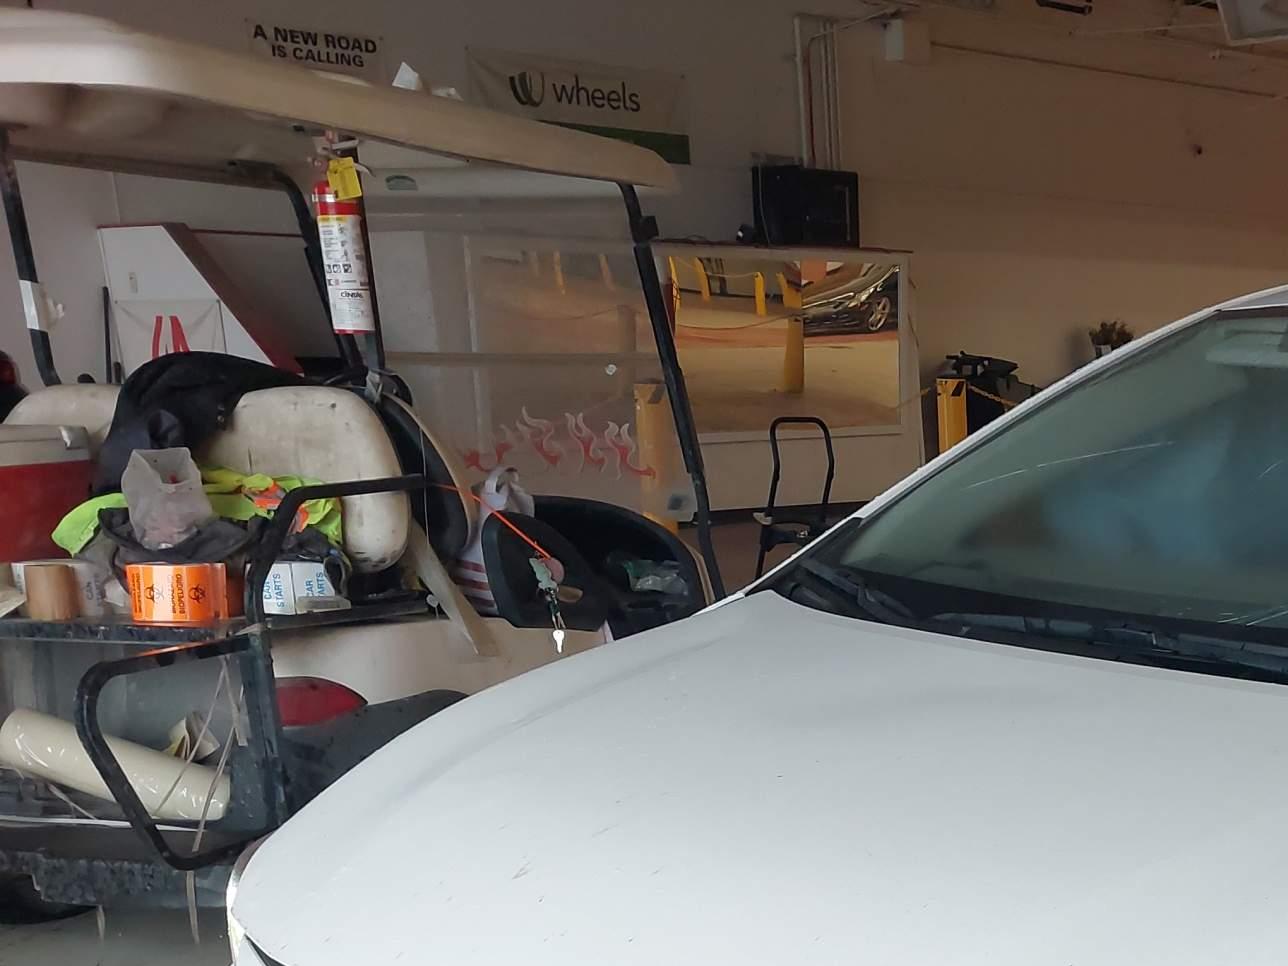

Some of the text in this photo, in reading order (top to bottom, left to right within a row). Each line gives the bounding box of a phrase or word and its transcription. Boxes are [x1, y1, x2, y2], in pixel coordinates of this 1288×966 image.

[253, 24, 377, 53] A NEW ROAD
[271, 44, 364, 67] IS CALLING
[552, 74, 641, 112] wheels
[273, 573, 285, 608] STARTS
[316, 572, 325, 597] ARTS
